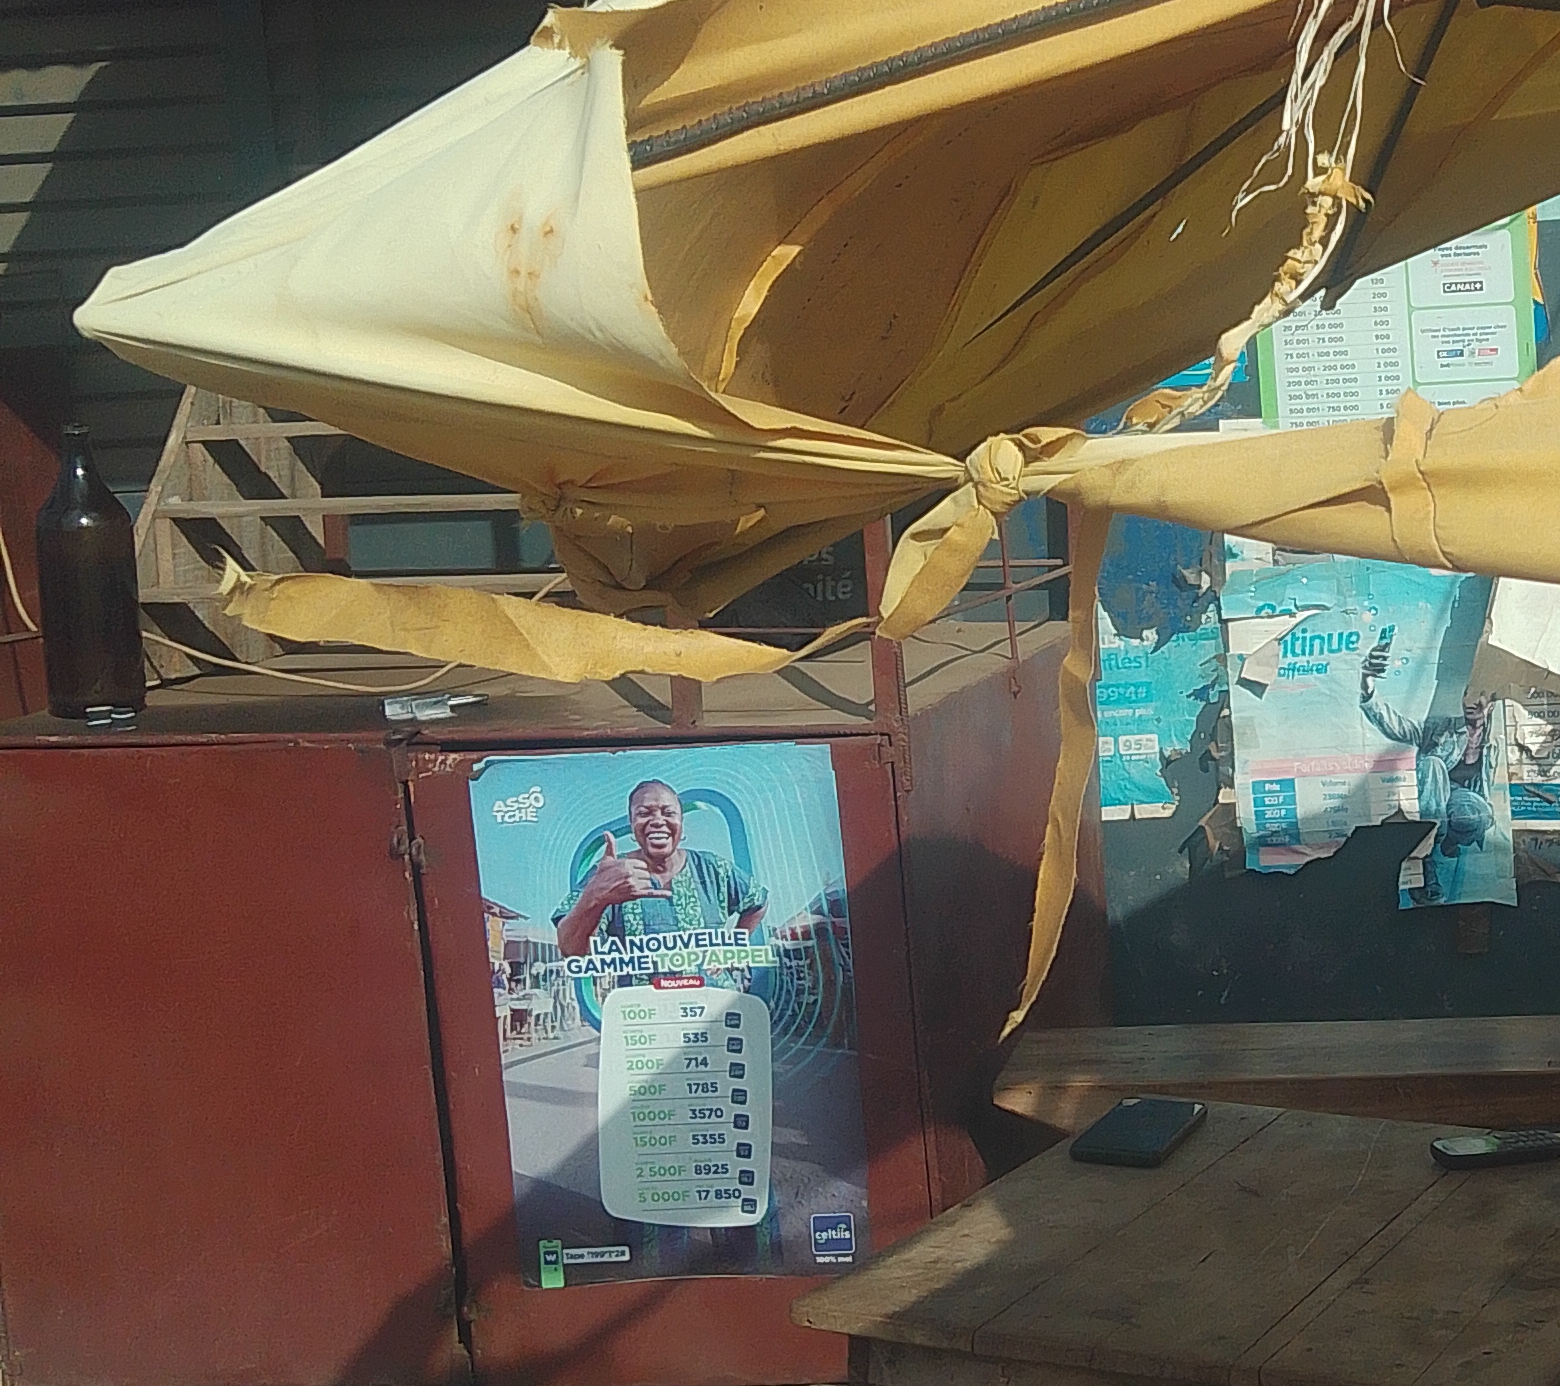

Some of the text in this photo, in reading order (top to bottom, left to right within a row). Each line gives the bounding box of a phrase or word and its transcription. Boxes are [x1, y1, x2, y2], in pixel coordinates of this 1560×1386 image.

[1444, 282, 1482, 292] CANAL+
[1371, 291, 1388, 300] 200
[592, 930, 748, 956] LA NOUVELLE
[566, 947, 778, 975] GAMME TOP APPEL
[660, 977, 701, 988] NOUVEAU
[621, 1006, 706, 1021] 100F 357
[623, 1031, 709, 1046] 150F 535
[626, 1057, 709, 1071] 200F 714
[628, 1082, 719, 1097] 500F 1785
[630, 1107, 724, 1123] 1000F 3570
[632, 1133, 726, 1148] 1500F 5355
[693, 1164, 729, 1176] 8925
